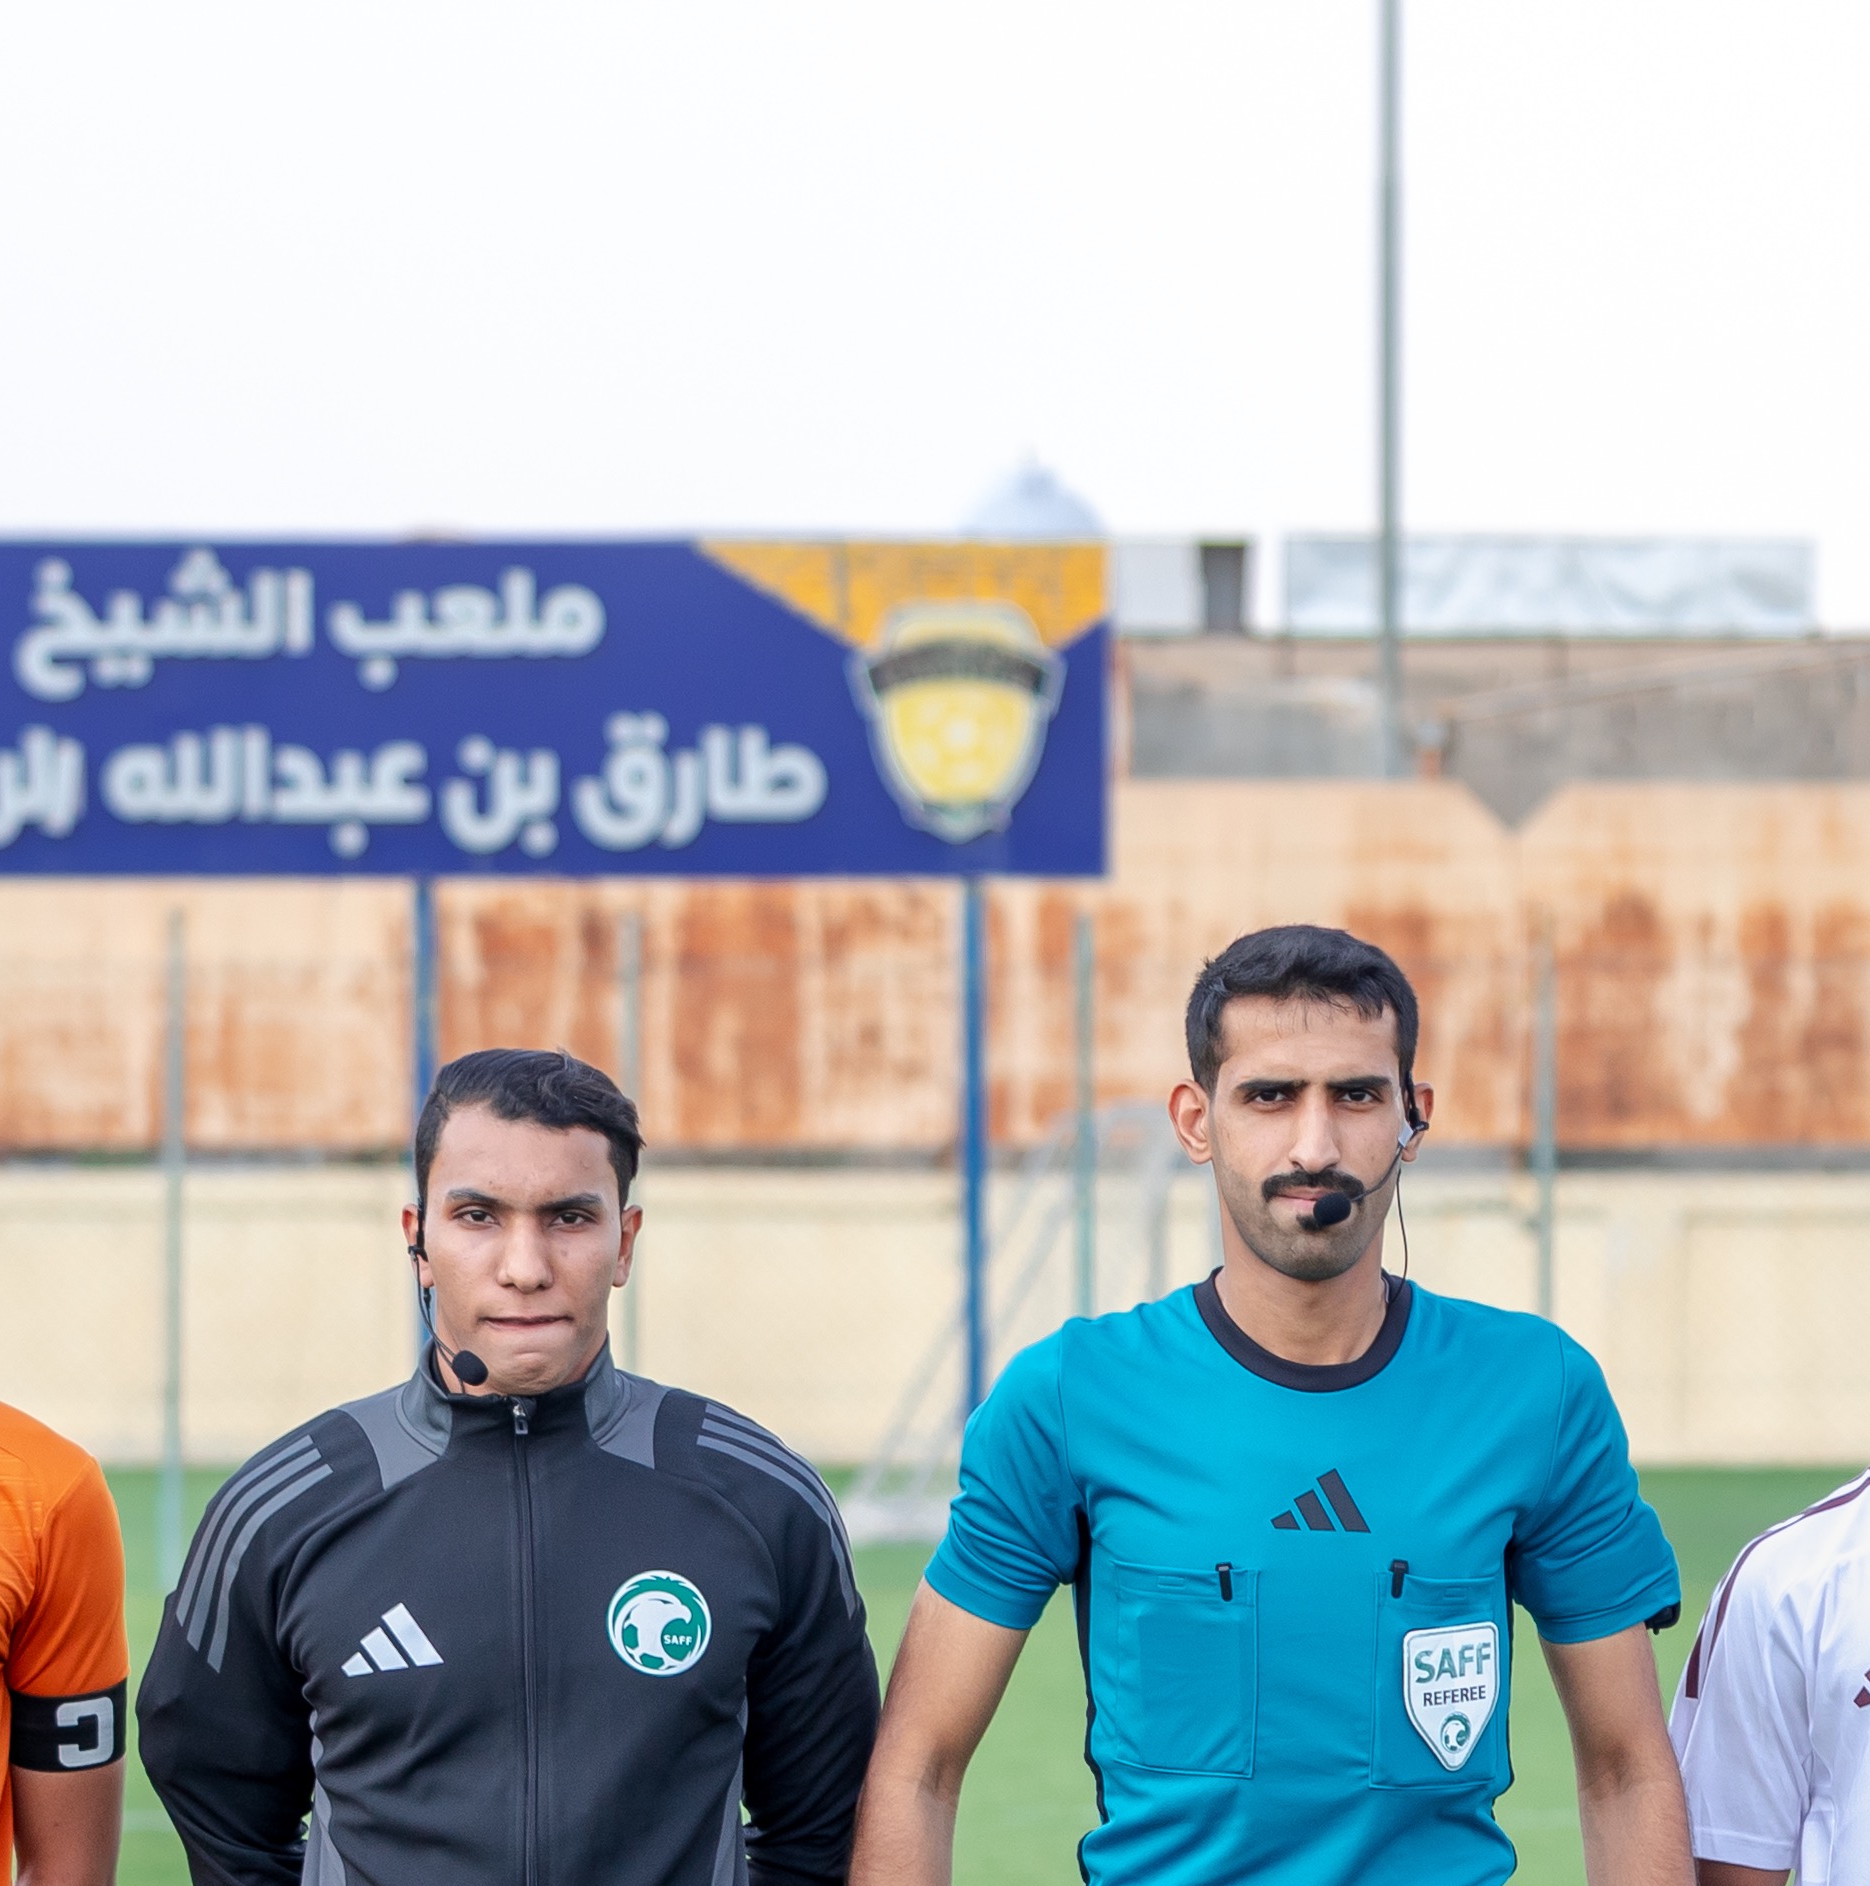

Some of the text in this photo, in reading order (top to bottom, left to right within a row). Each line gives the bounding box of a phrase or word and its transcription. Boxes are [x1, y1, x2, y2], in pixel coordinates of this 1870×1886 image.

[12, 547, 605, 701] ملعب الشيخ
[101, 723, 430, 859] عبدالله
[440, 733, 561, 859] بن
[570, 710, 828, 852] طارق
[663, 1634, 692, 1646] SAFF
[1414, 1642, 1491, 1685] SAFF
[1423, 1685, 1486, 1707] REFEREE
